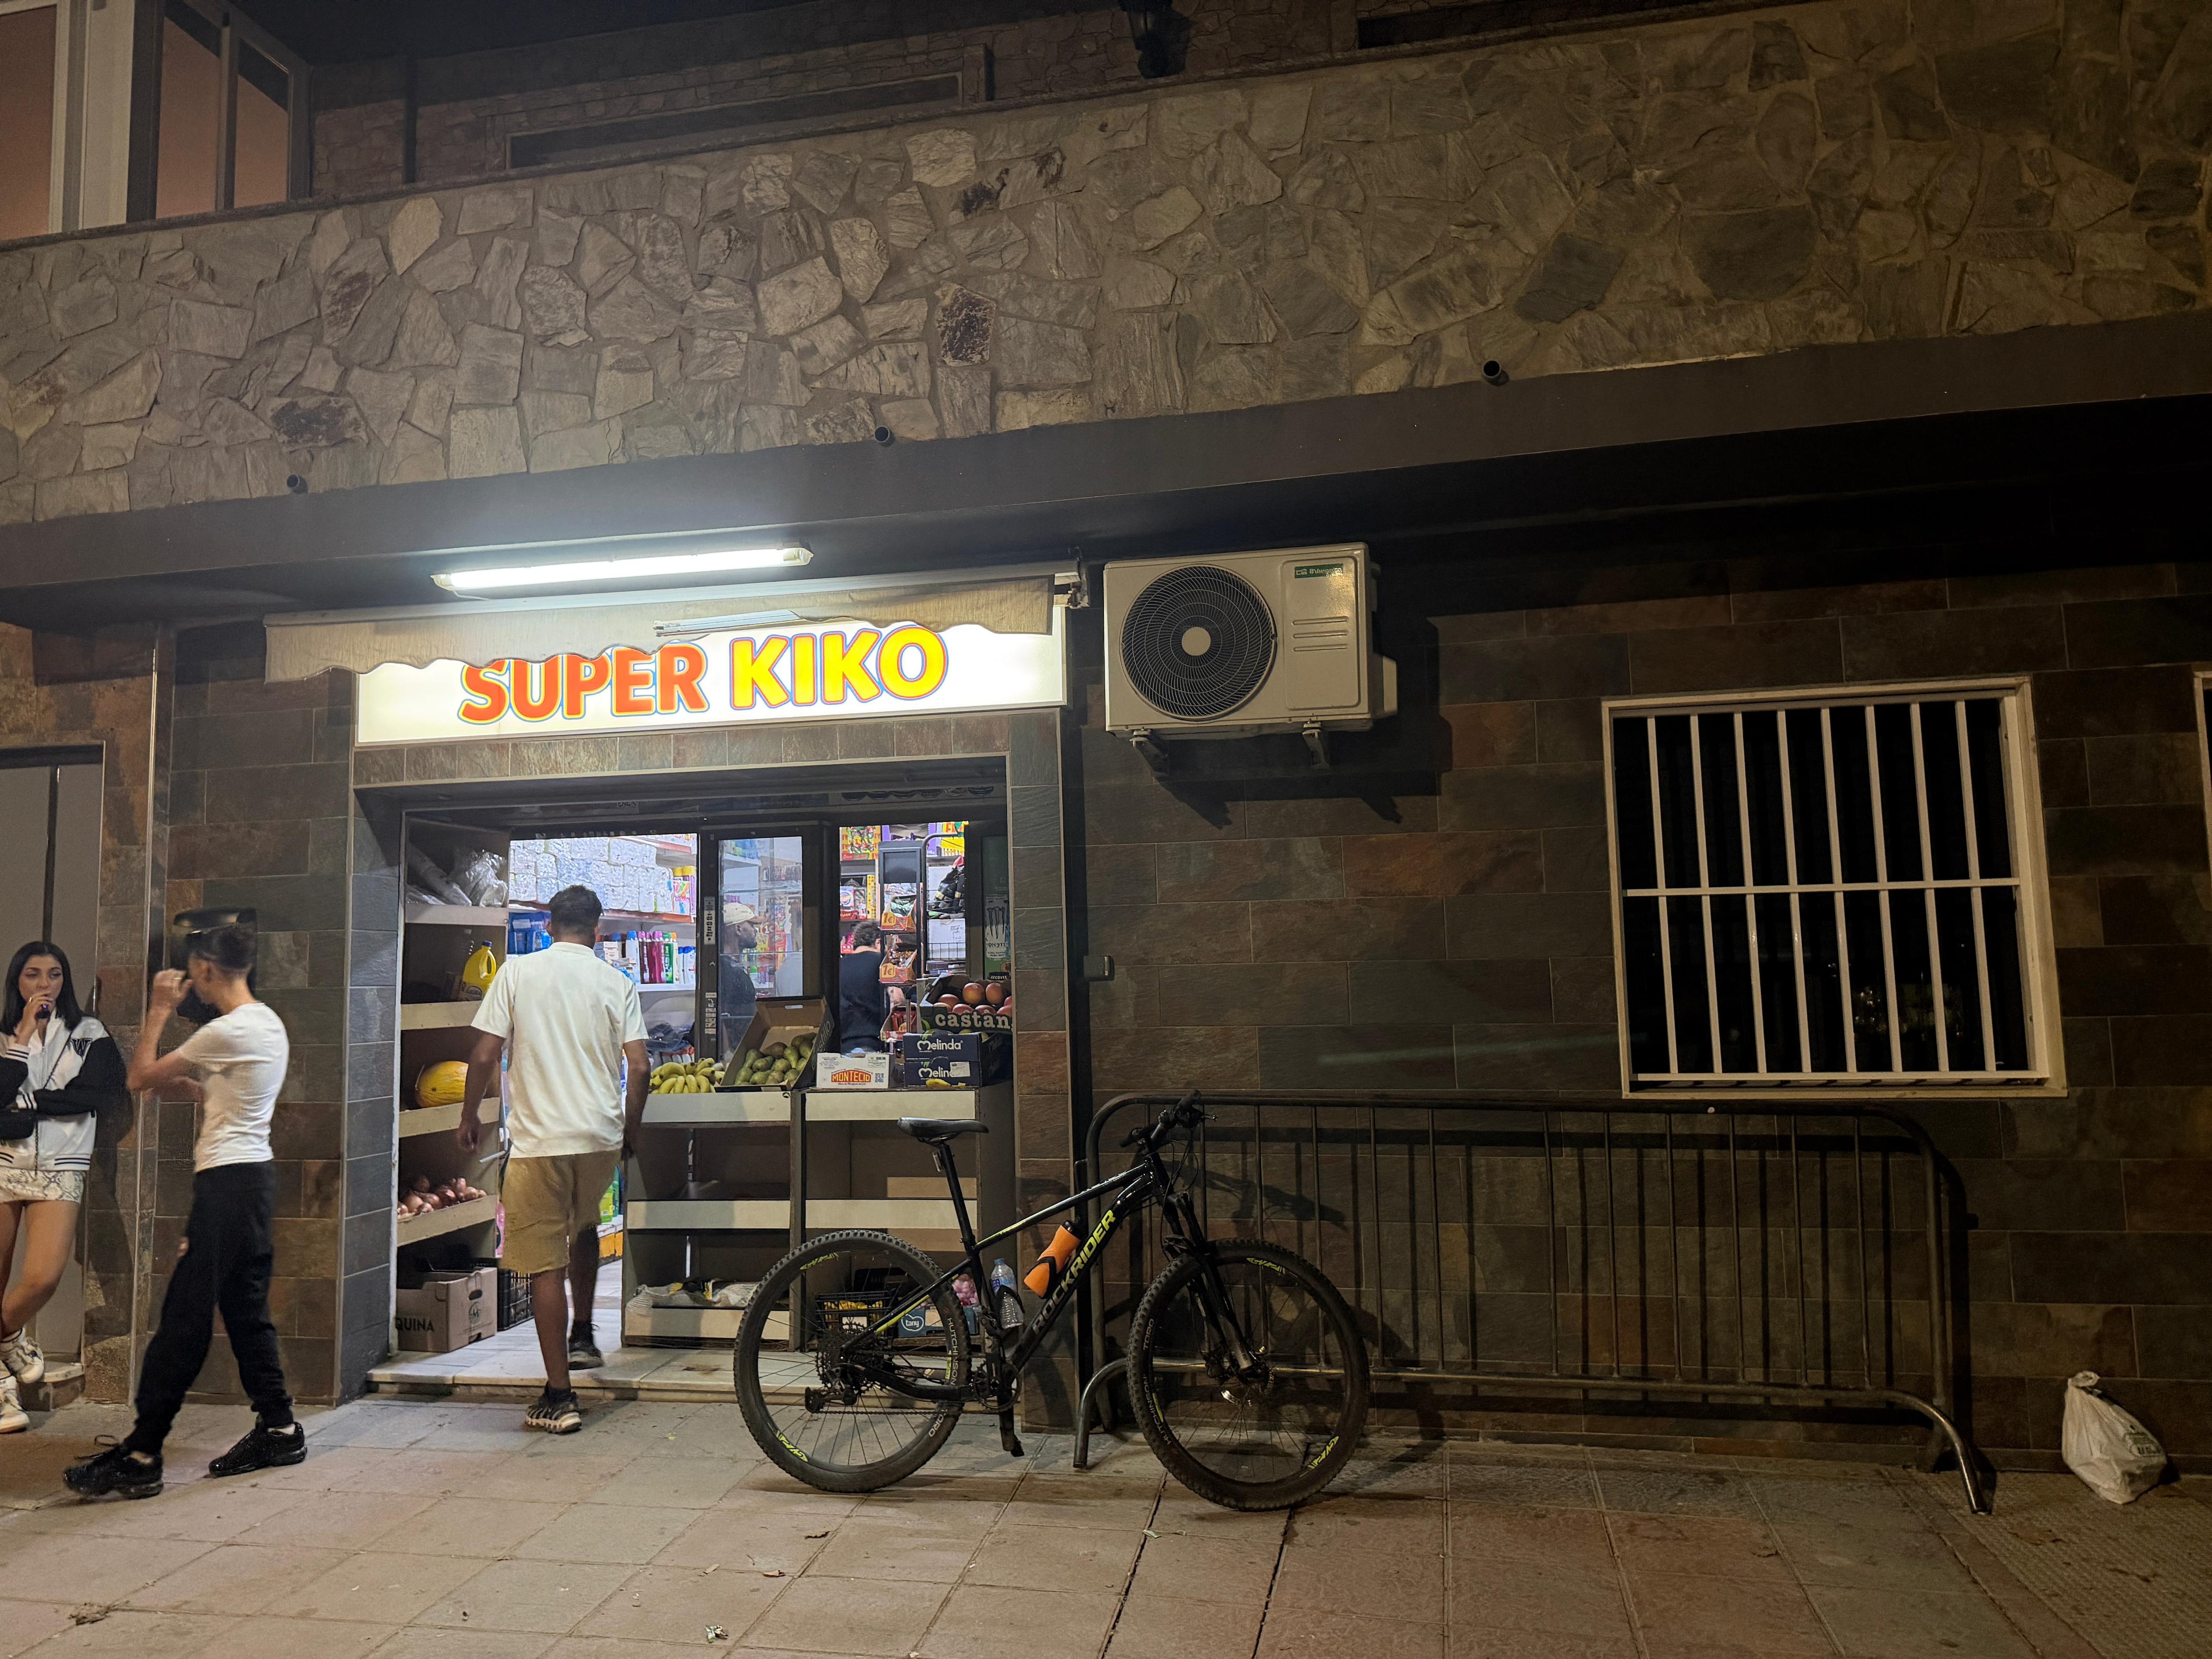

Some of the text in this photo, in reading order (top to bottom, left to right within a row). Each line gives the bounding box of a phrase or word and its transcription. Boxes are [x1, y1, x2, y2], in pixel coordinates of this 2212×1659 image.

[458, 625, 949, 724] SUPER KIKO
[935, 1012, 1013, 1032] castan
[917, 1038, 961, 1050] Melinda
[832, 1071, 870, 1082] MONTECID
[918, 1066, 952, 1078] Melin
[1032, 1210, 1116, 1336] ROCKRIDER
[947, 1318, 958, 1385] HUTCHINSON
[1143, 1376, 1172, 1445] HUTCHINSON
